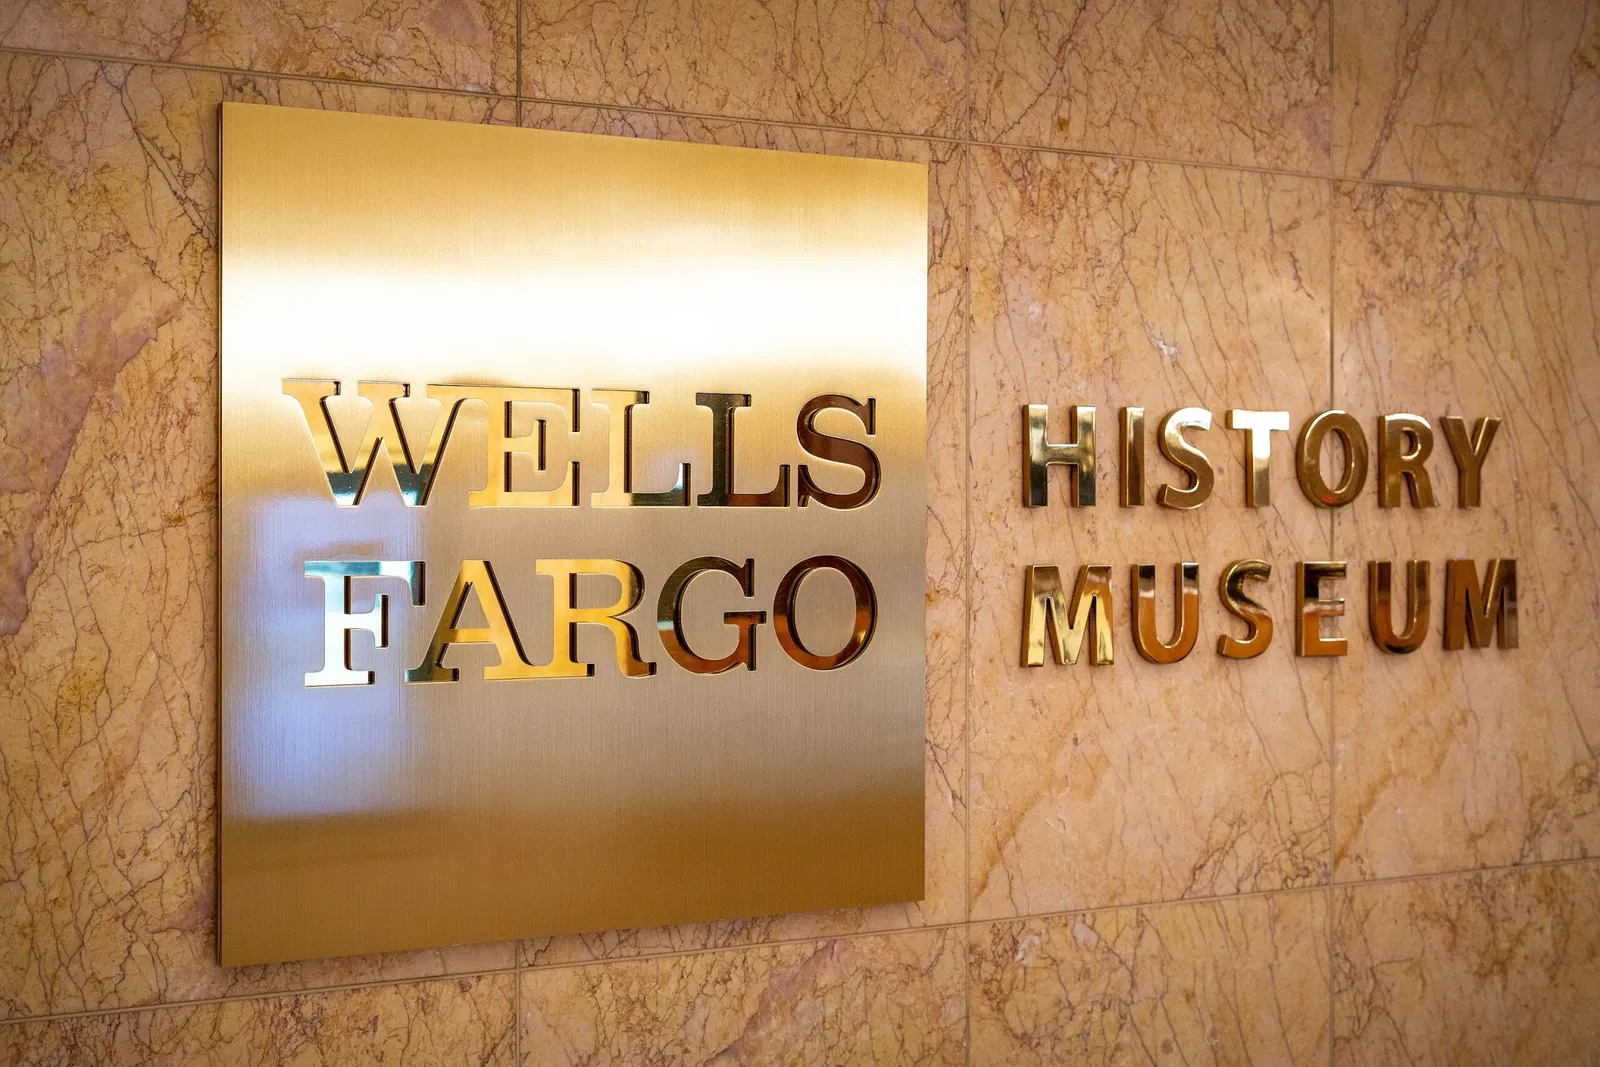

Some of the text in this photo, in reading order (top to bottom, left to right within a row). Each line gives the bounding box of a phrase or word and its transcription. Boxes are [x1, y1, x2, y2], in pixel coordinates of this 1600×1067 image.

[282, 378, 881, 510] WELLS
[1022, 404, 1500, 509] HISTORY
[304, 555, 877, 687] FARGO
[1020, 559, 1518, 668] MUSEUM
